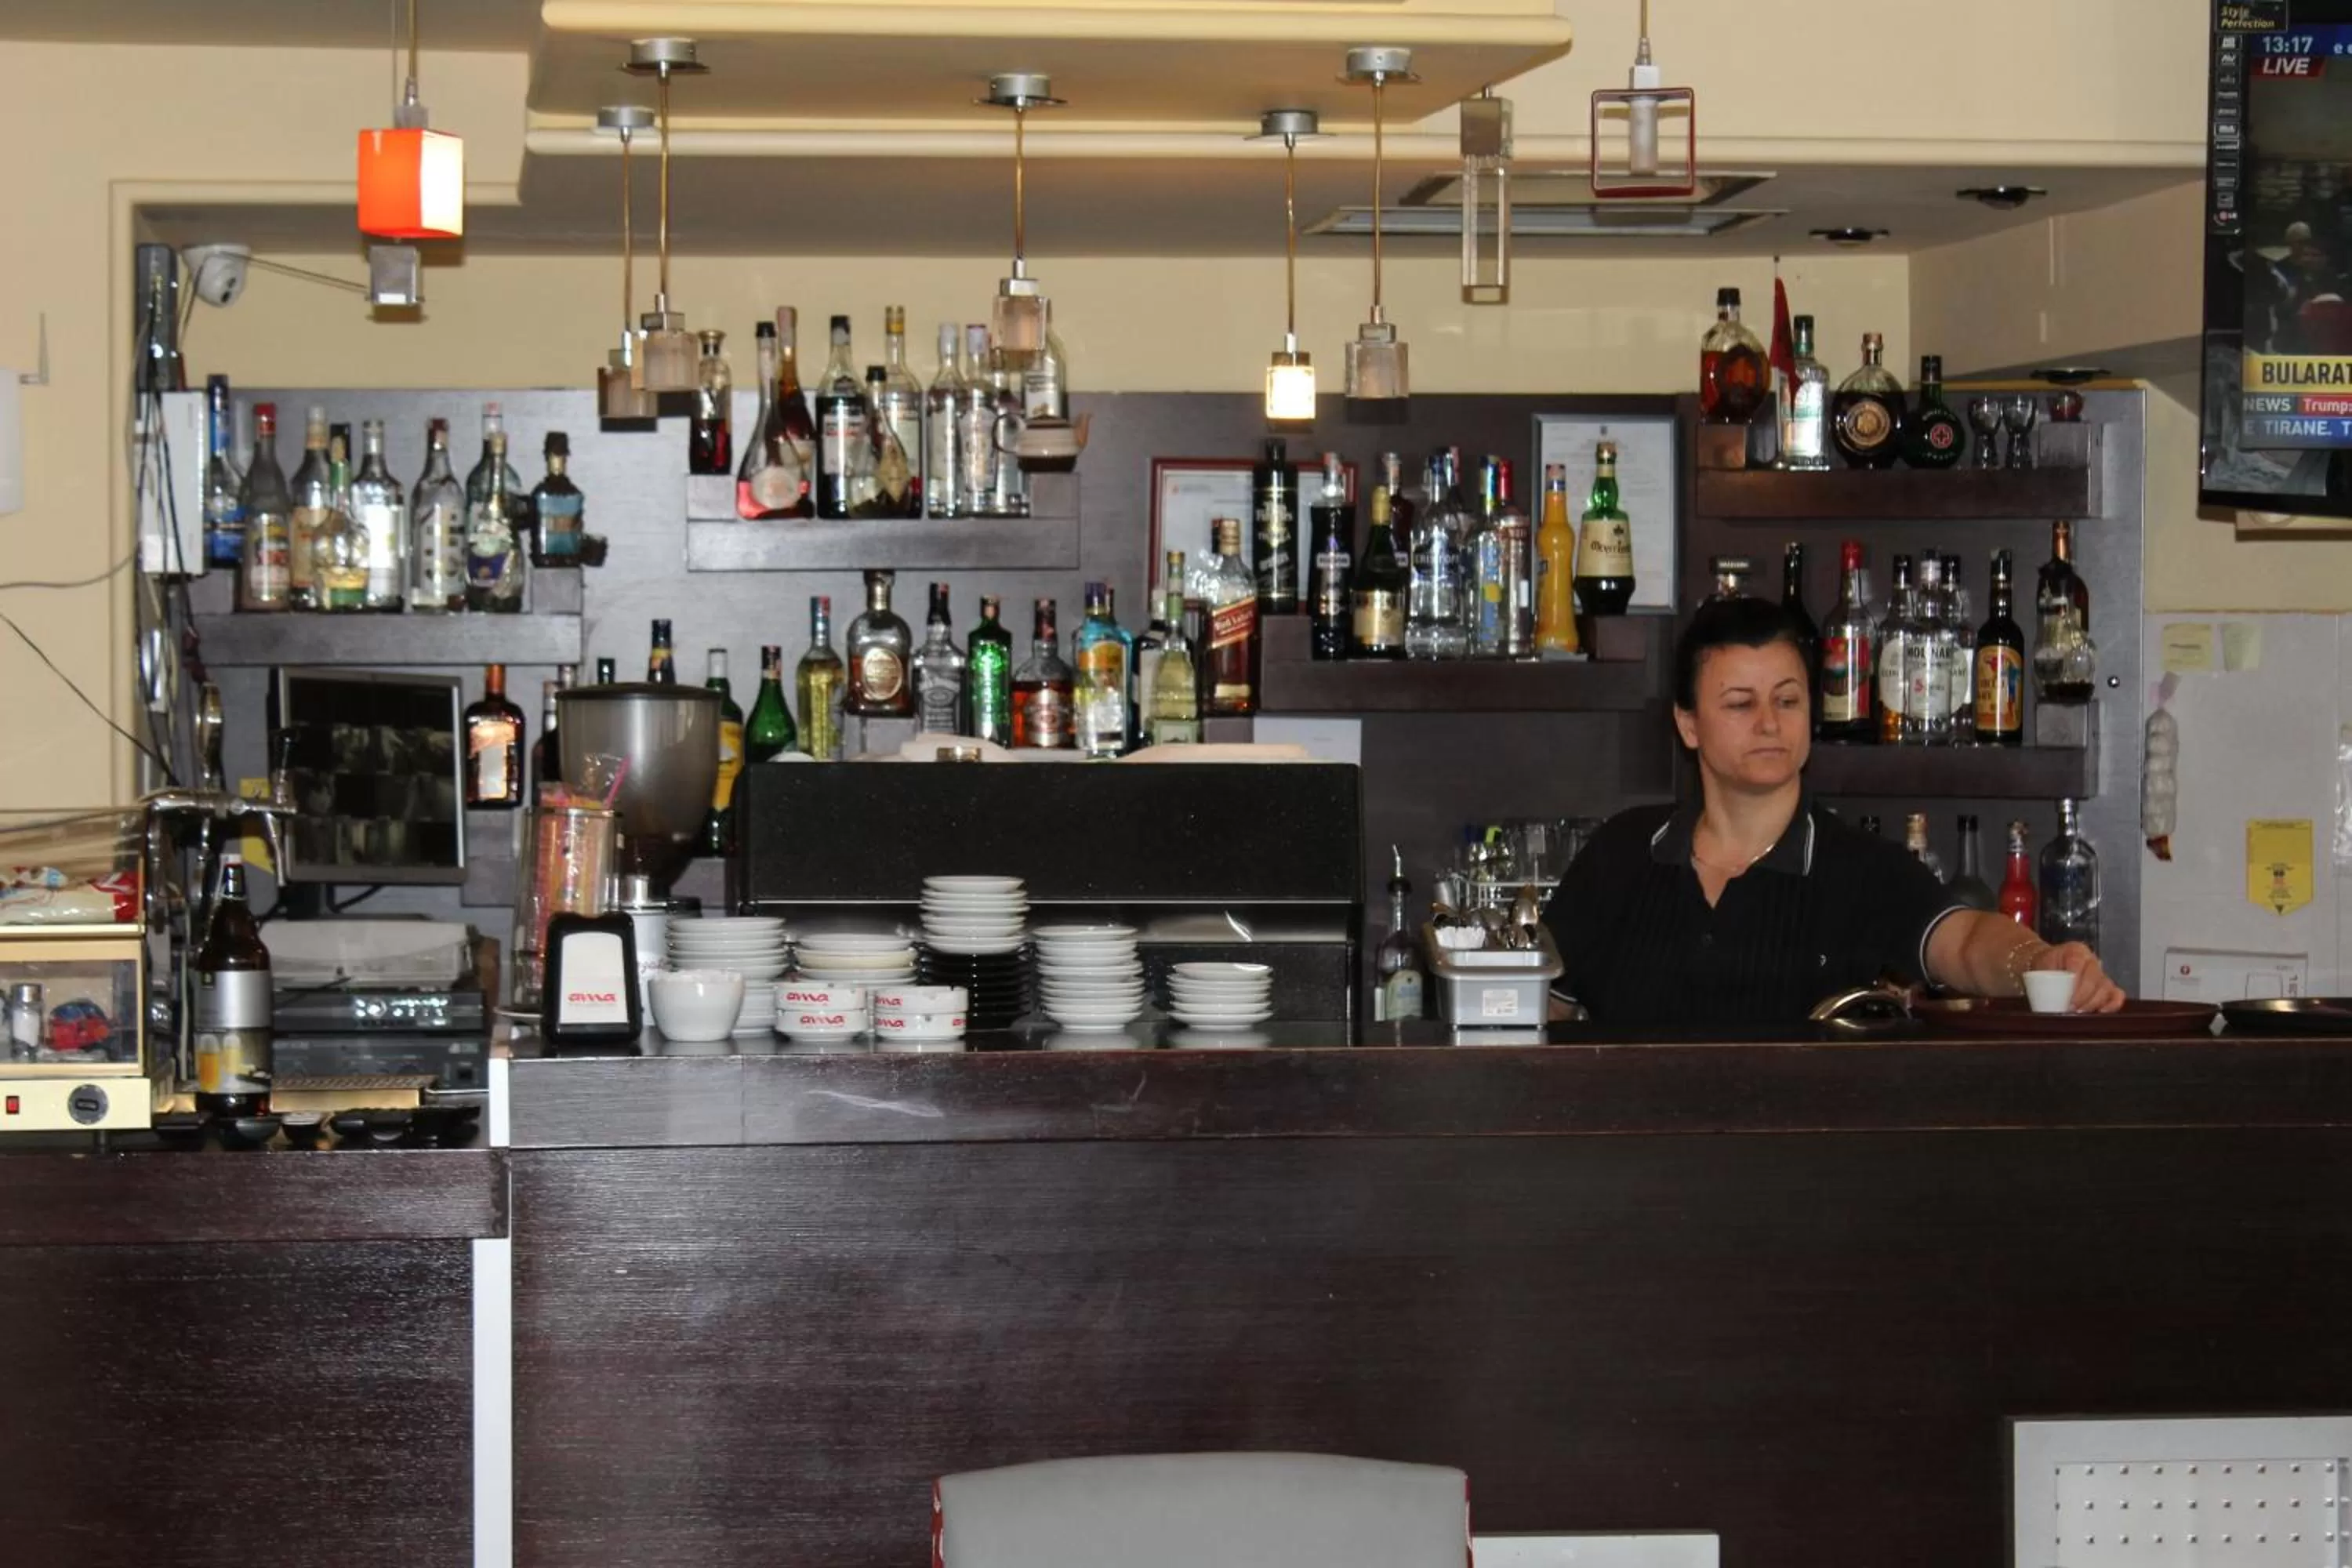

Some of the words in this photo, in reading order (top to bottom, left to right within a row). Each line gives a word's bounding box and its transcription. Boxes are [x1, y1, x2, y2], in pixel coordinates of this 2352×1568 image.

[2221, 18, 2275, 28] Perfection
[2263, 36, 2313, 53] 13:17
[2263, 57, 2310, 74] LIVE
[2244, 397, 2291, 412] NEWS
